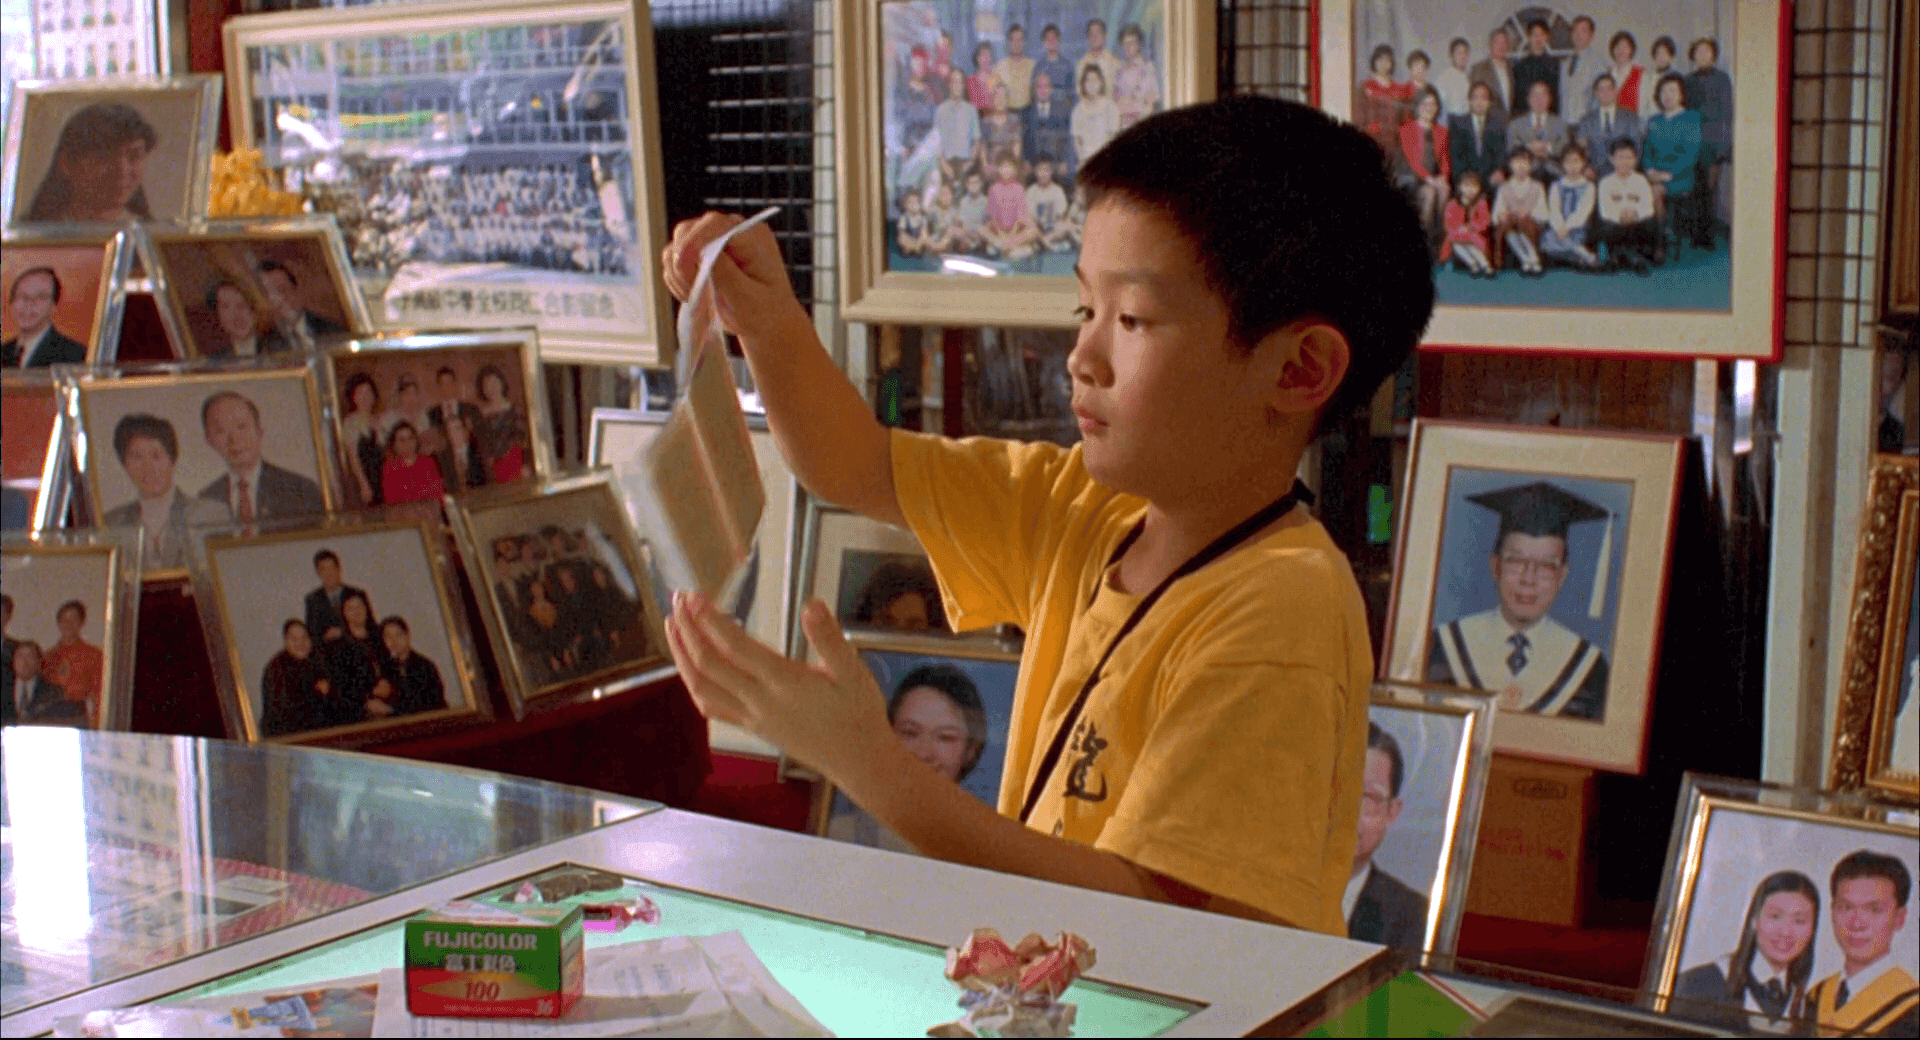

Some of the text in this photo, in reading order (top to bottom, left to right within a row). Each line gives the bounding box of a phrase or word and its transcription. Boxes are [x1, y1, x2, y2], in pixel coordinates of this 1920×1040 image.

[423, 930, 538, 951] FUJICOLOR
[445, 953, 517, 973] 富士彩色
[465, 980, 500, 1001] 100
